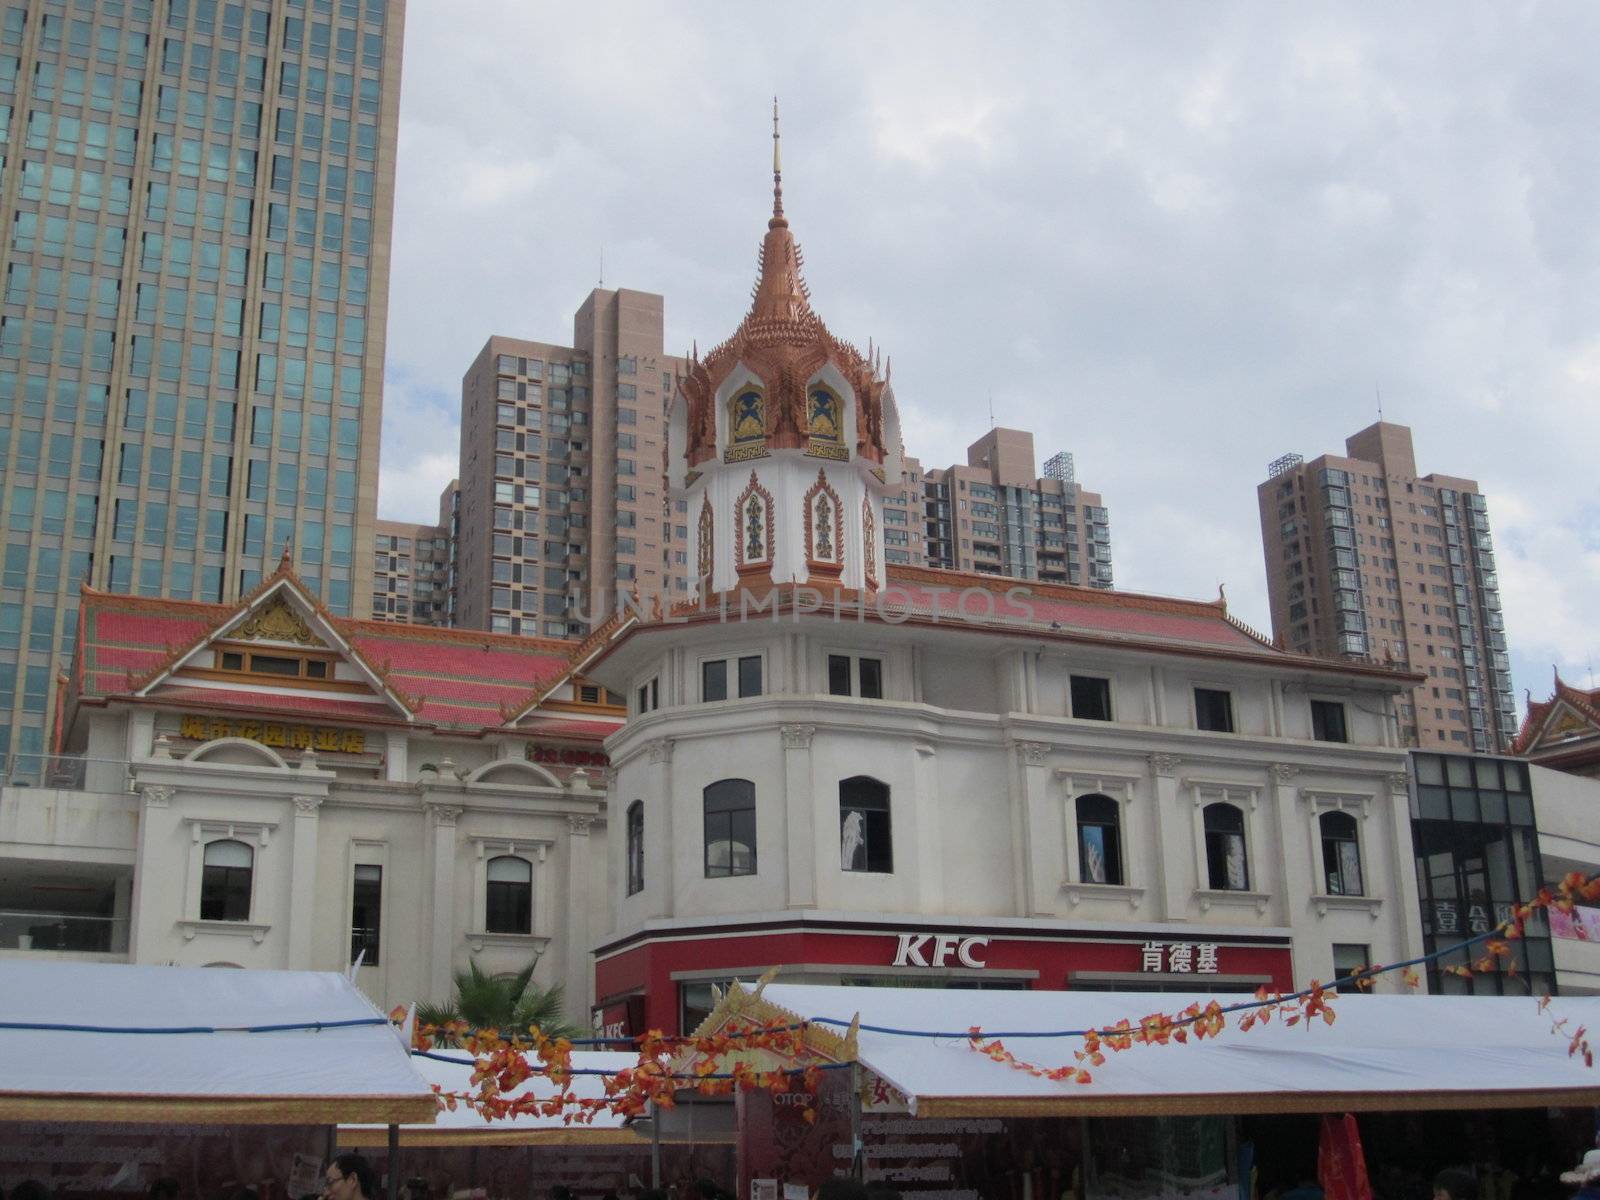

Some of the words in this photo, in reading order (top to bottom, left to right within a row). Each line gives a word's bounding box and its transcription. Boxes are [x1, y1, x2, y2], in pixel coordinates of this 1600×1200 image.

[891, 933, 990, 969] KFC
[1141, 940, 1219, 974] 肯德基
